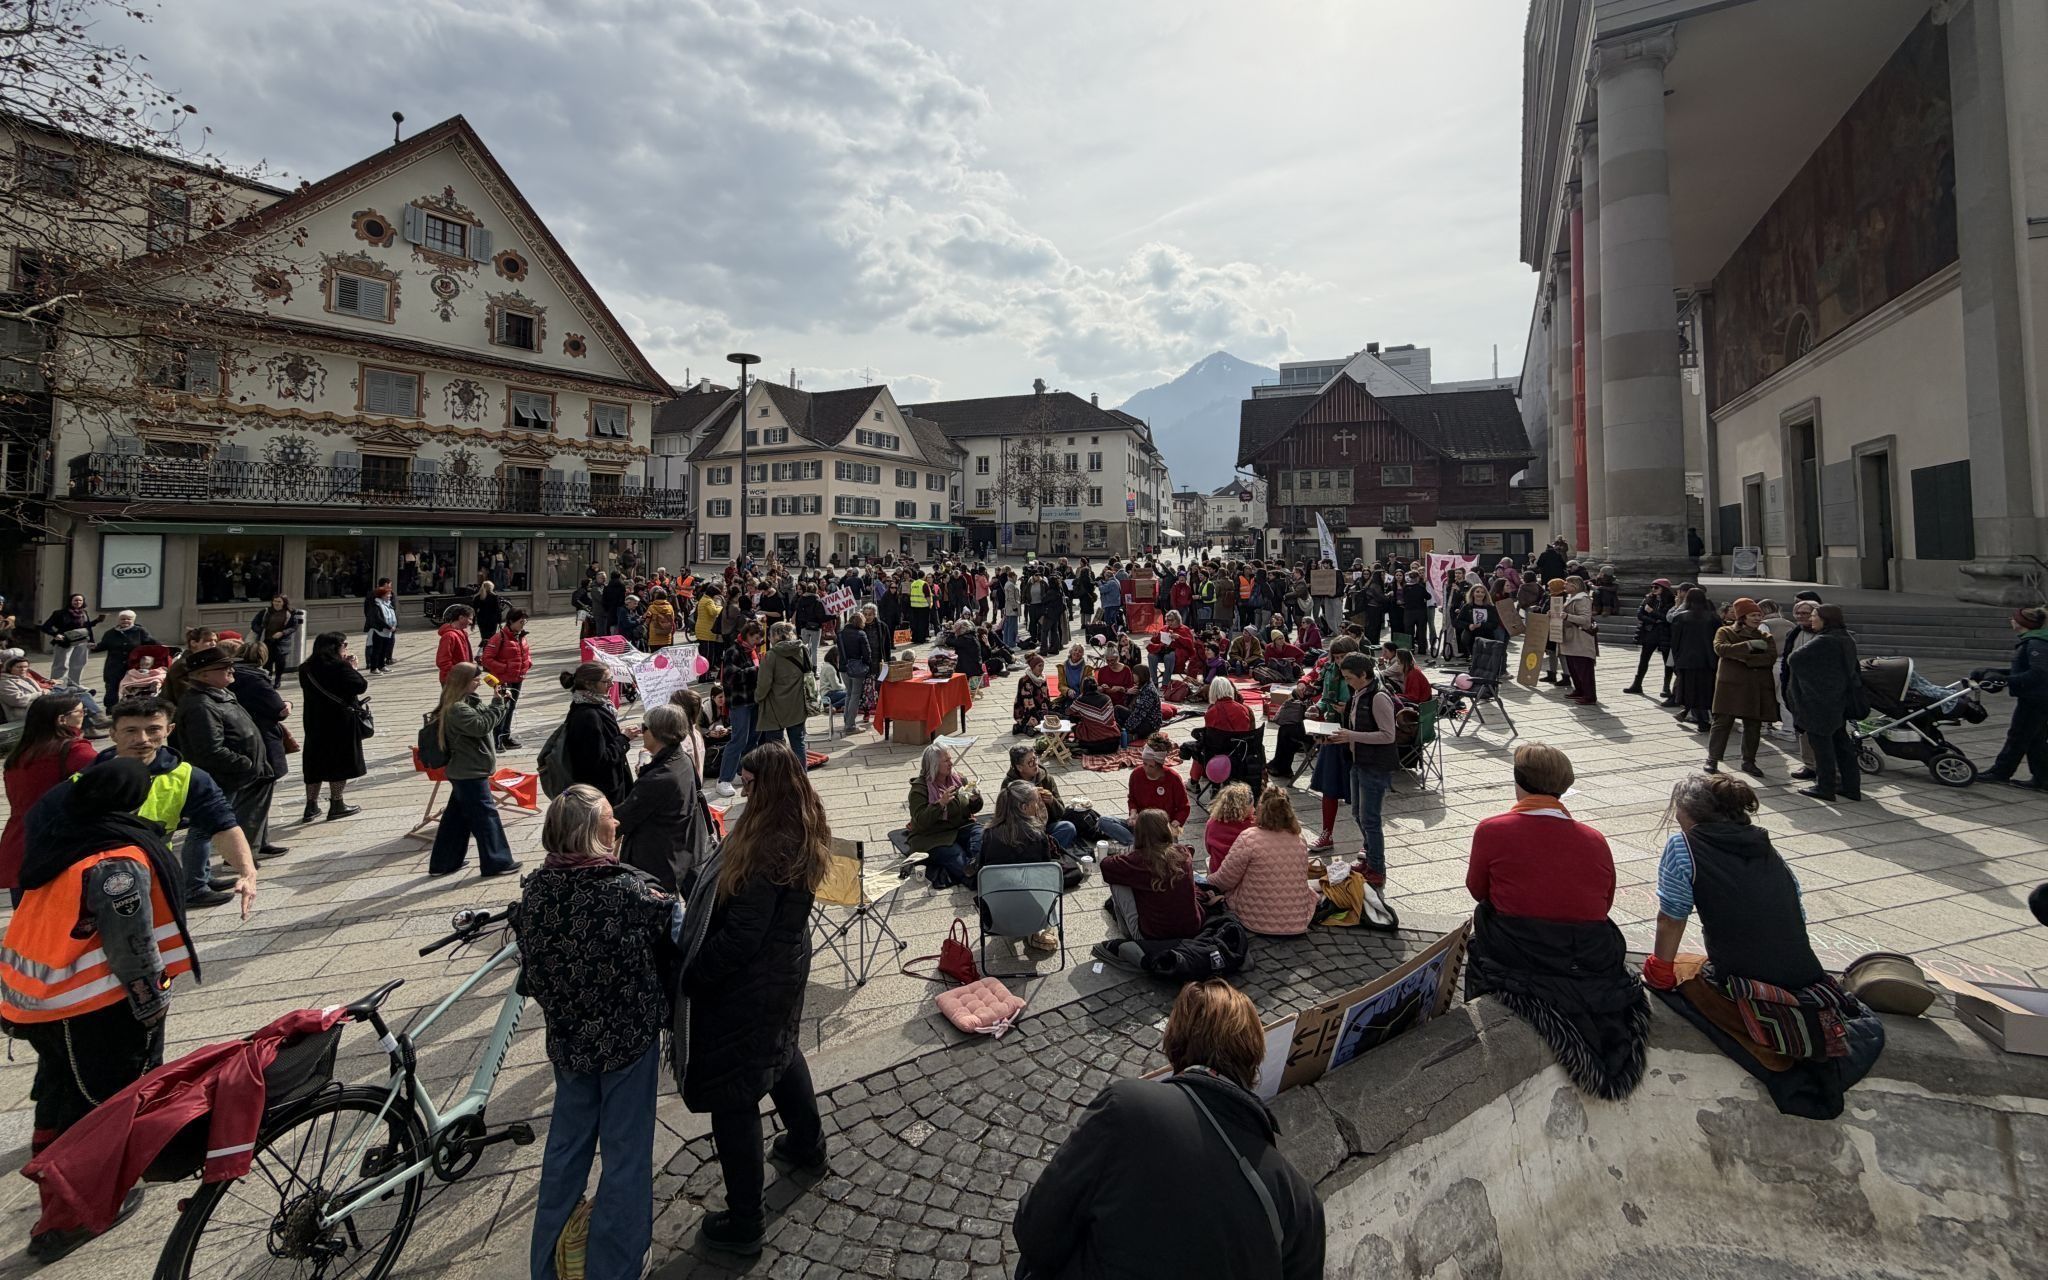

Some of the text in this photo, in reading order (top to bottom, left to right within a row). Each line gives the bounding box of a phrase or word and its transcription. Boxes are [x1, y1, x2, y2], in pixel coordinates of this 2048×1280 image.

[822, 587, 852, 606] VIVA LA
[827, 598, 855, 614] VULVA
